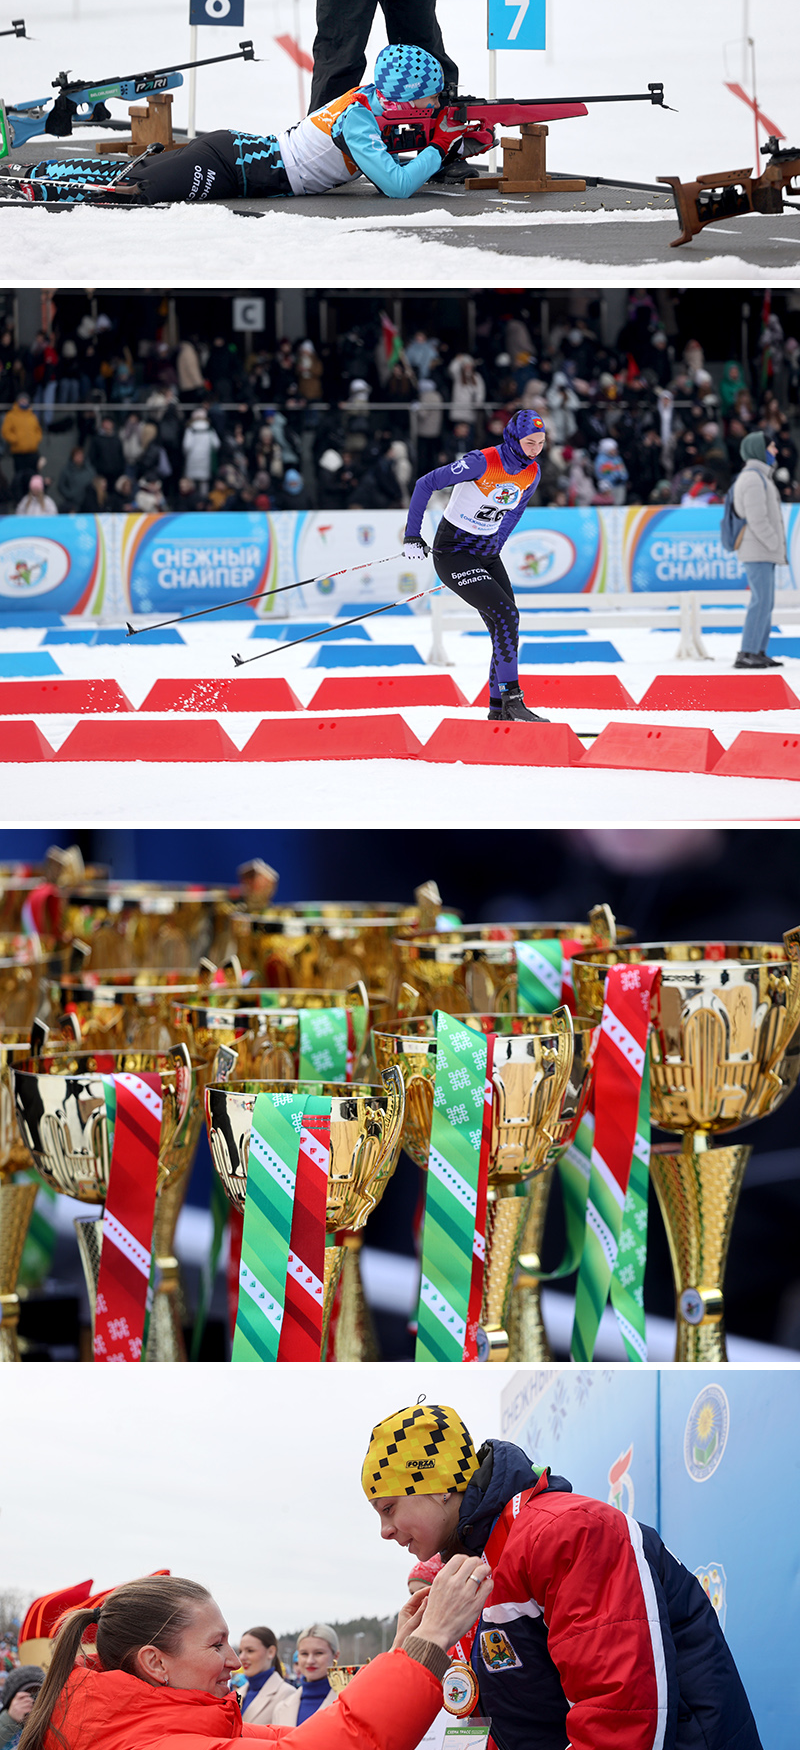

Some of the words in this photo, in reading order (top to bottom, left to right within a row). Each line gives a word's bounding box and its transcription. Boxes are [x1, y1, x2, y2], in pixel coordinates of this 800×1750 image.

[135, 77, 168, 93] PARI
[200, 168, 216, 200] Минс
[152, 544, 260, 569] СНЕЖНЫЙ
[158, 567, 255, 589] СНАЙПЕР
[451, 567, 489, 580] Брестск
[458, 574, 492, 586] область
[407, 1459, 434, 1468] FORZA
